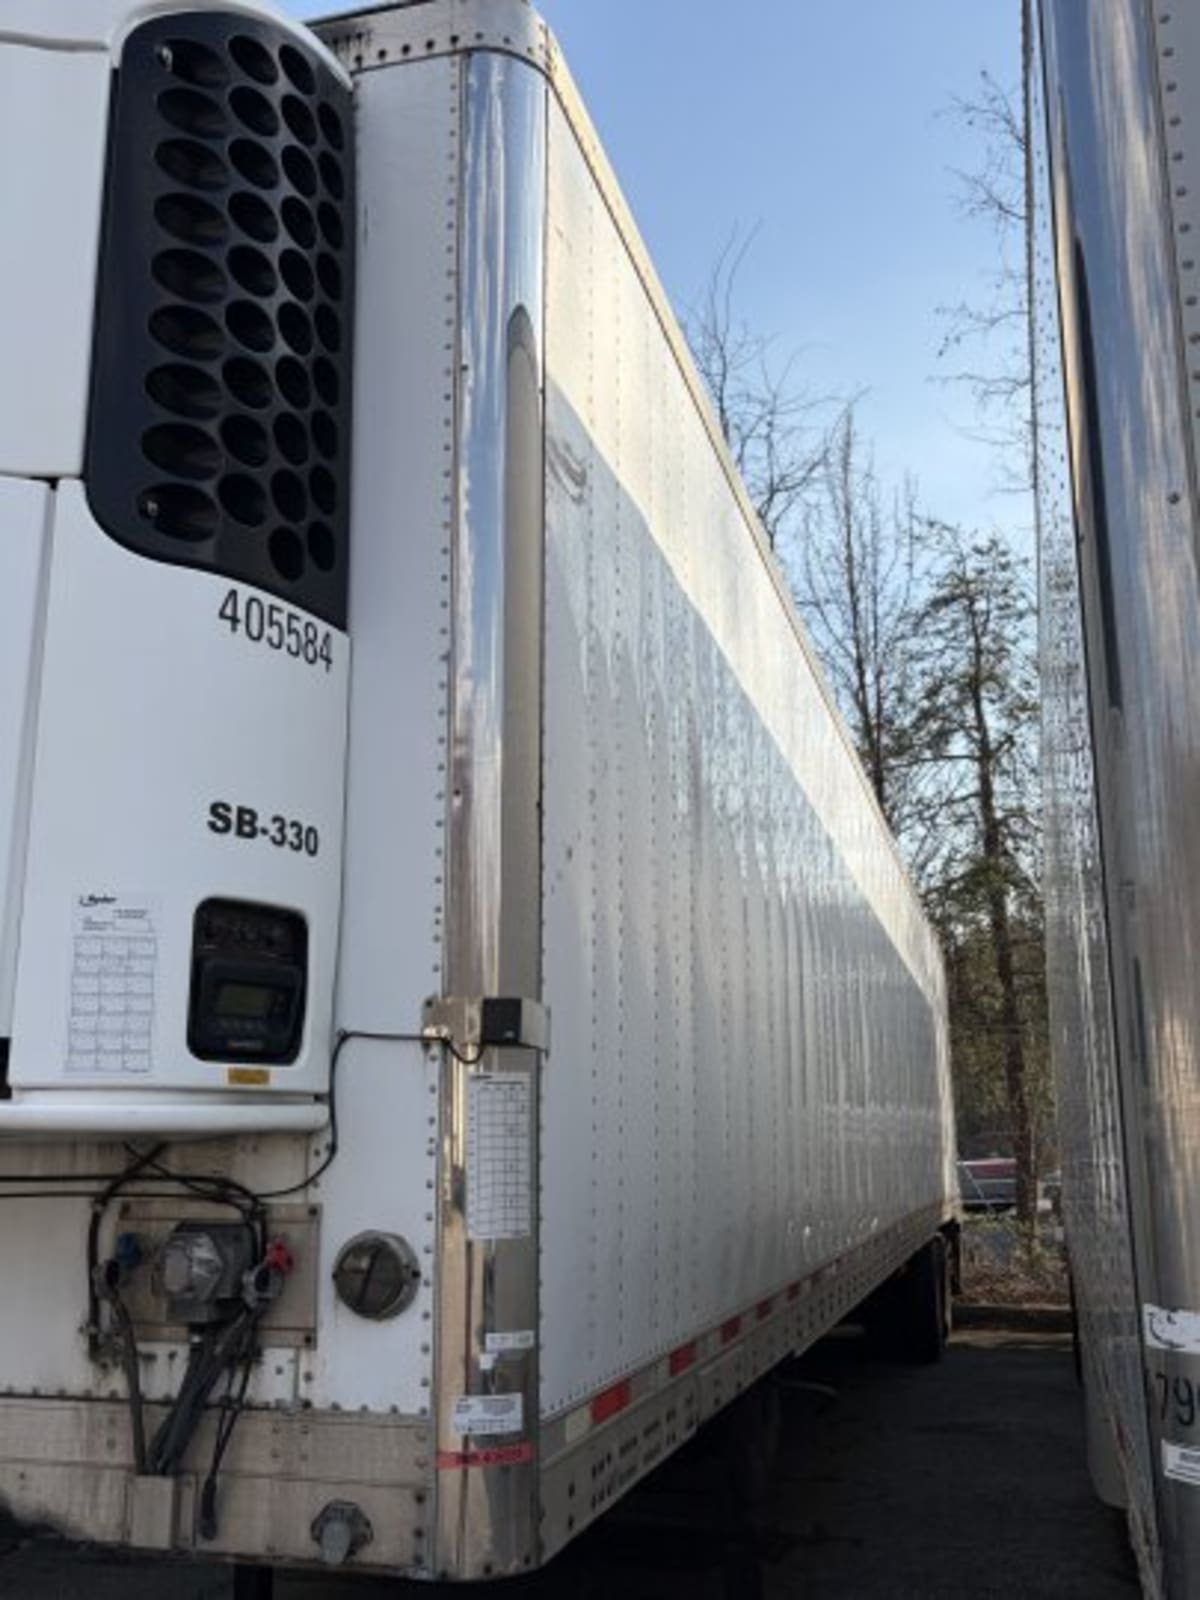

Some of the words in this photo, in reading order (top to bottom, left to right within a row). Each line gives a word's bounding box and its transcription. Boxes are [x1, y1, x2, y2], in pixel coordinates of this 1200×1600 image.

[218, 588, 333, 673] 405584
[207, 800, 319, 857] SB-330
[1155, 1371, 1200, 1427] 79
